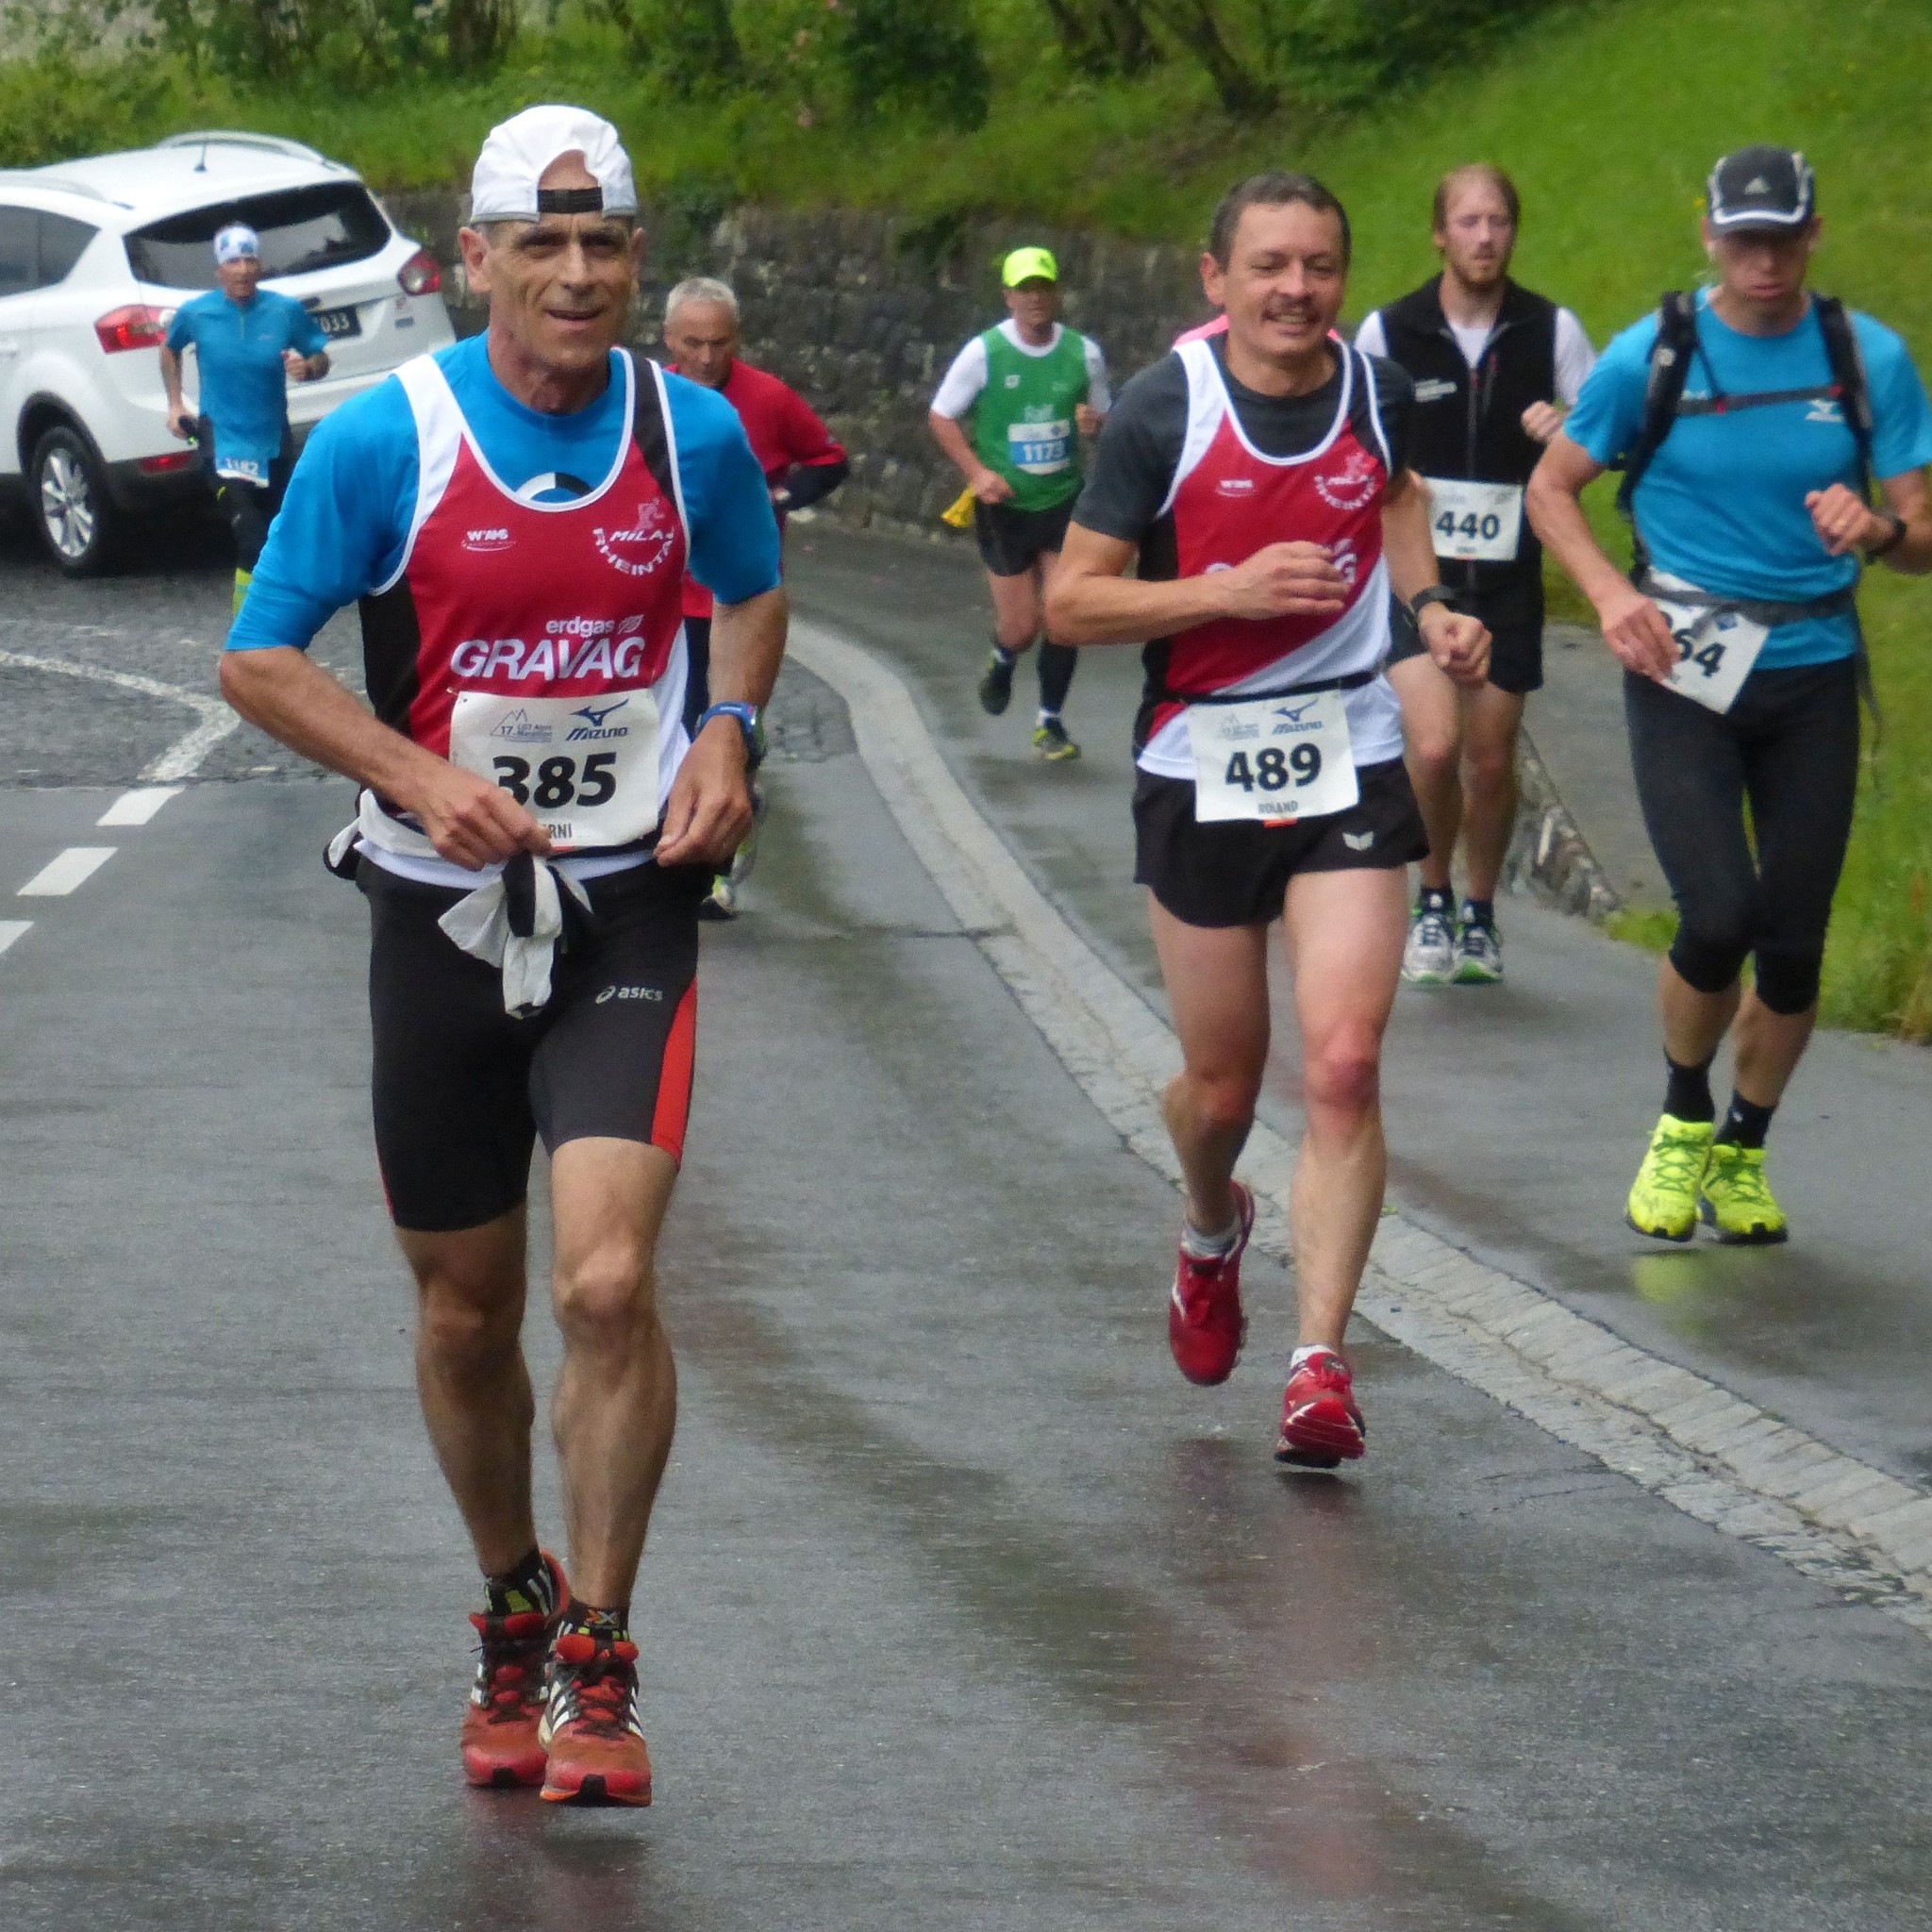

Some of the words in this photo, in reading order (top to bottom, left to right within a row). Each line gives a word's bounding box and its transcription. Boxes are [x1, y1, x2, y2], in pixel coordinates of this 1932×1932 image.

[1436, 510, 1500, 541] 440
[546, 616, 615, 638] erdgas
[450, 637, 645, 680] GRAVAG
[492, 752, 617, 809] 385
[1226, 742, 1322, 792] 489
[546, 823, 574, 839] RNI
[618, 987, 663, 1002] asics
